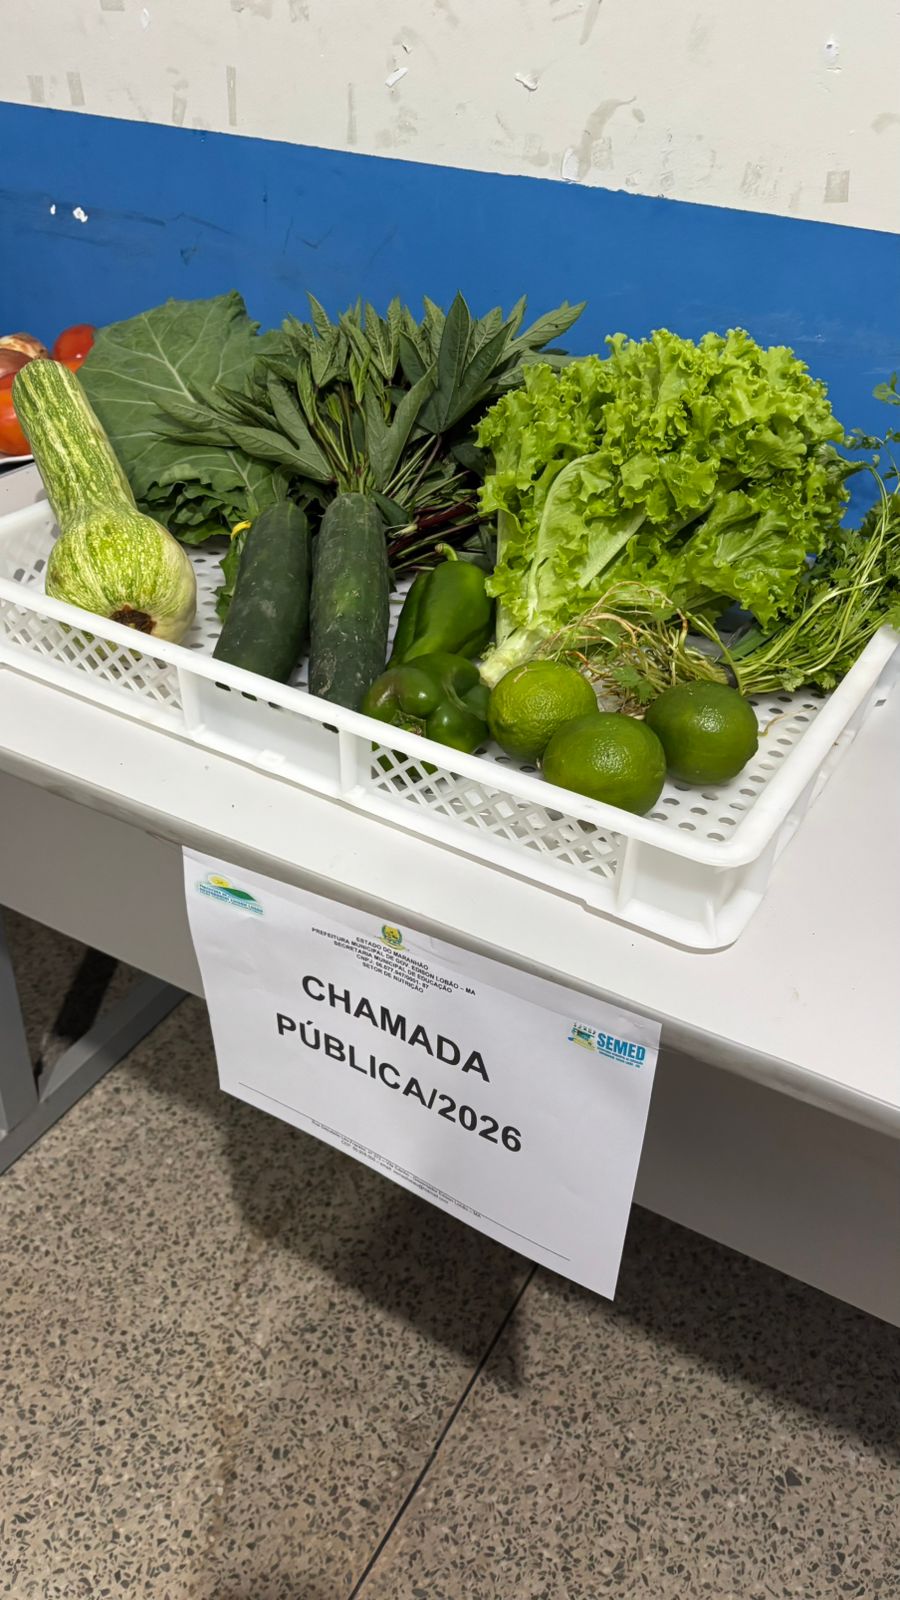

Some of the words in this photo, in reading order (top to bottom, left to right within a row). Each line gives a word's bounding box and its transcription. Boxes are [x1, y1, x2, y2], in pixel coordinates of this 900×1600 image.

[312, 927, 350, 945] PREFEITURA
[351, 941, 384, 958] MUNICIPAL
[386, 954, 394, 962] DE
[411, 965, 434, 980] EDISON
[436, 976, 458, 990] LOBÃO
[466, 987, 476, 996] MA
[334, 940, 372, 958] SECRETARIA
[374, 954, 406, 974] MUNICIPAL
[417, 973, 452, 993] EDUCAÇÃO
[356, 937, 382, 951] ESTADO
[382, 946, 394, 954] DO
[393, 951, 428, 970] MARANHÃO
[362, 962, 383, 974] SETOR
[393, 974, 424, 993] NUTRIÇÃO
[301, 974, 490, 1083] CHAMADA
[596, 1032, 646, 1061] SEMED
[275, 1011, 522, 1153] PÚBLICA/2026
